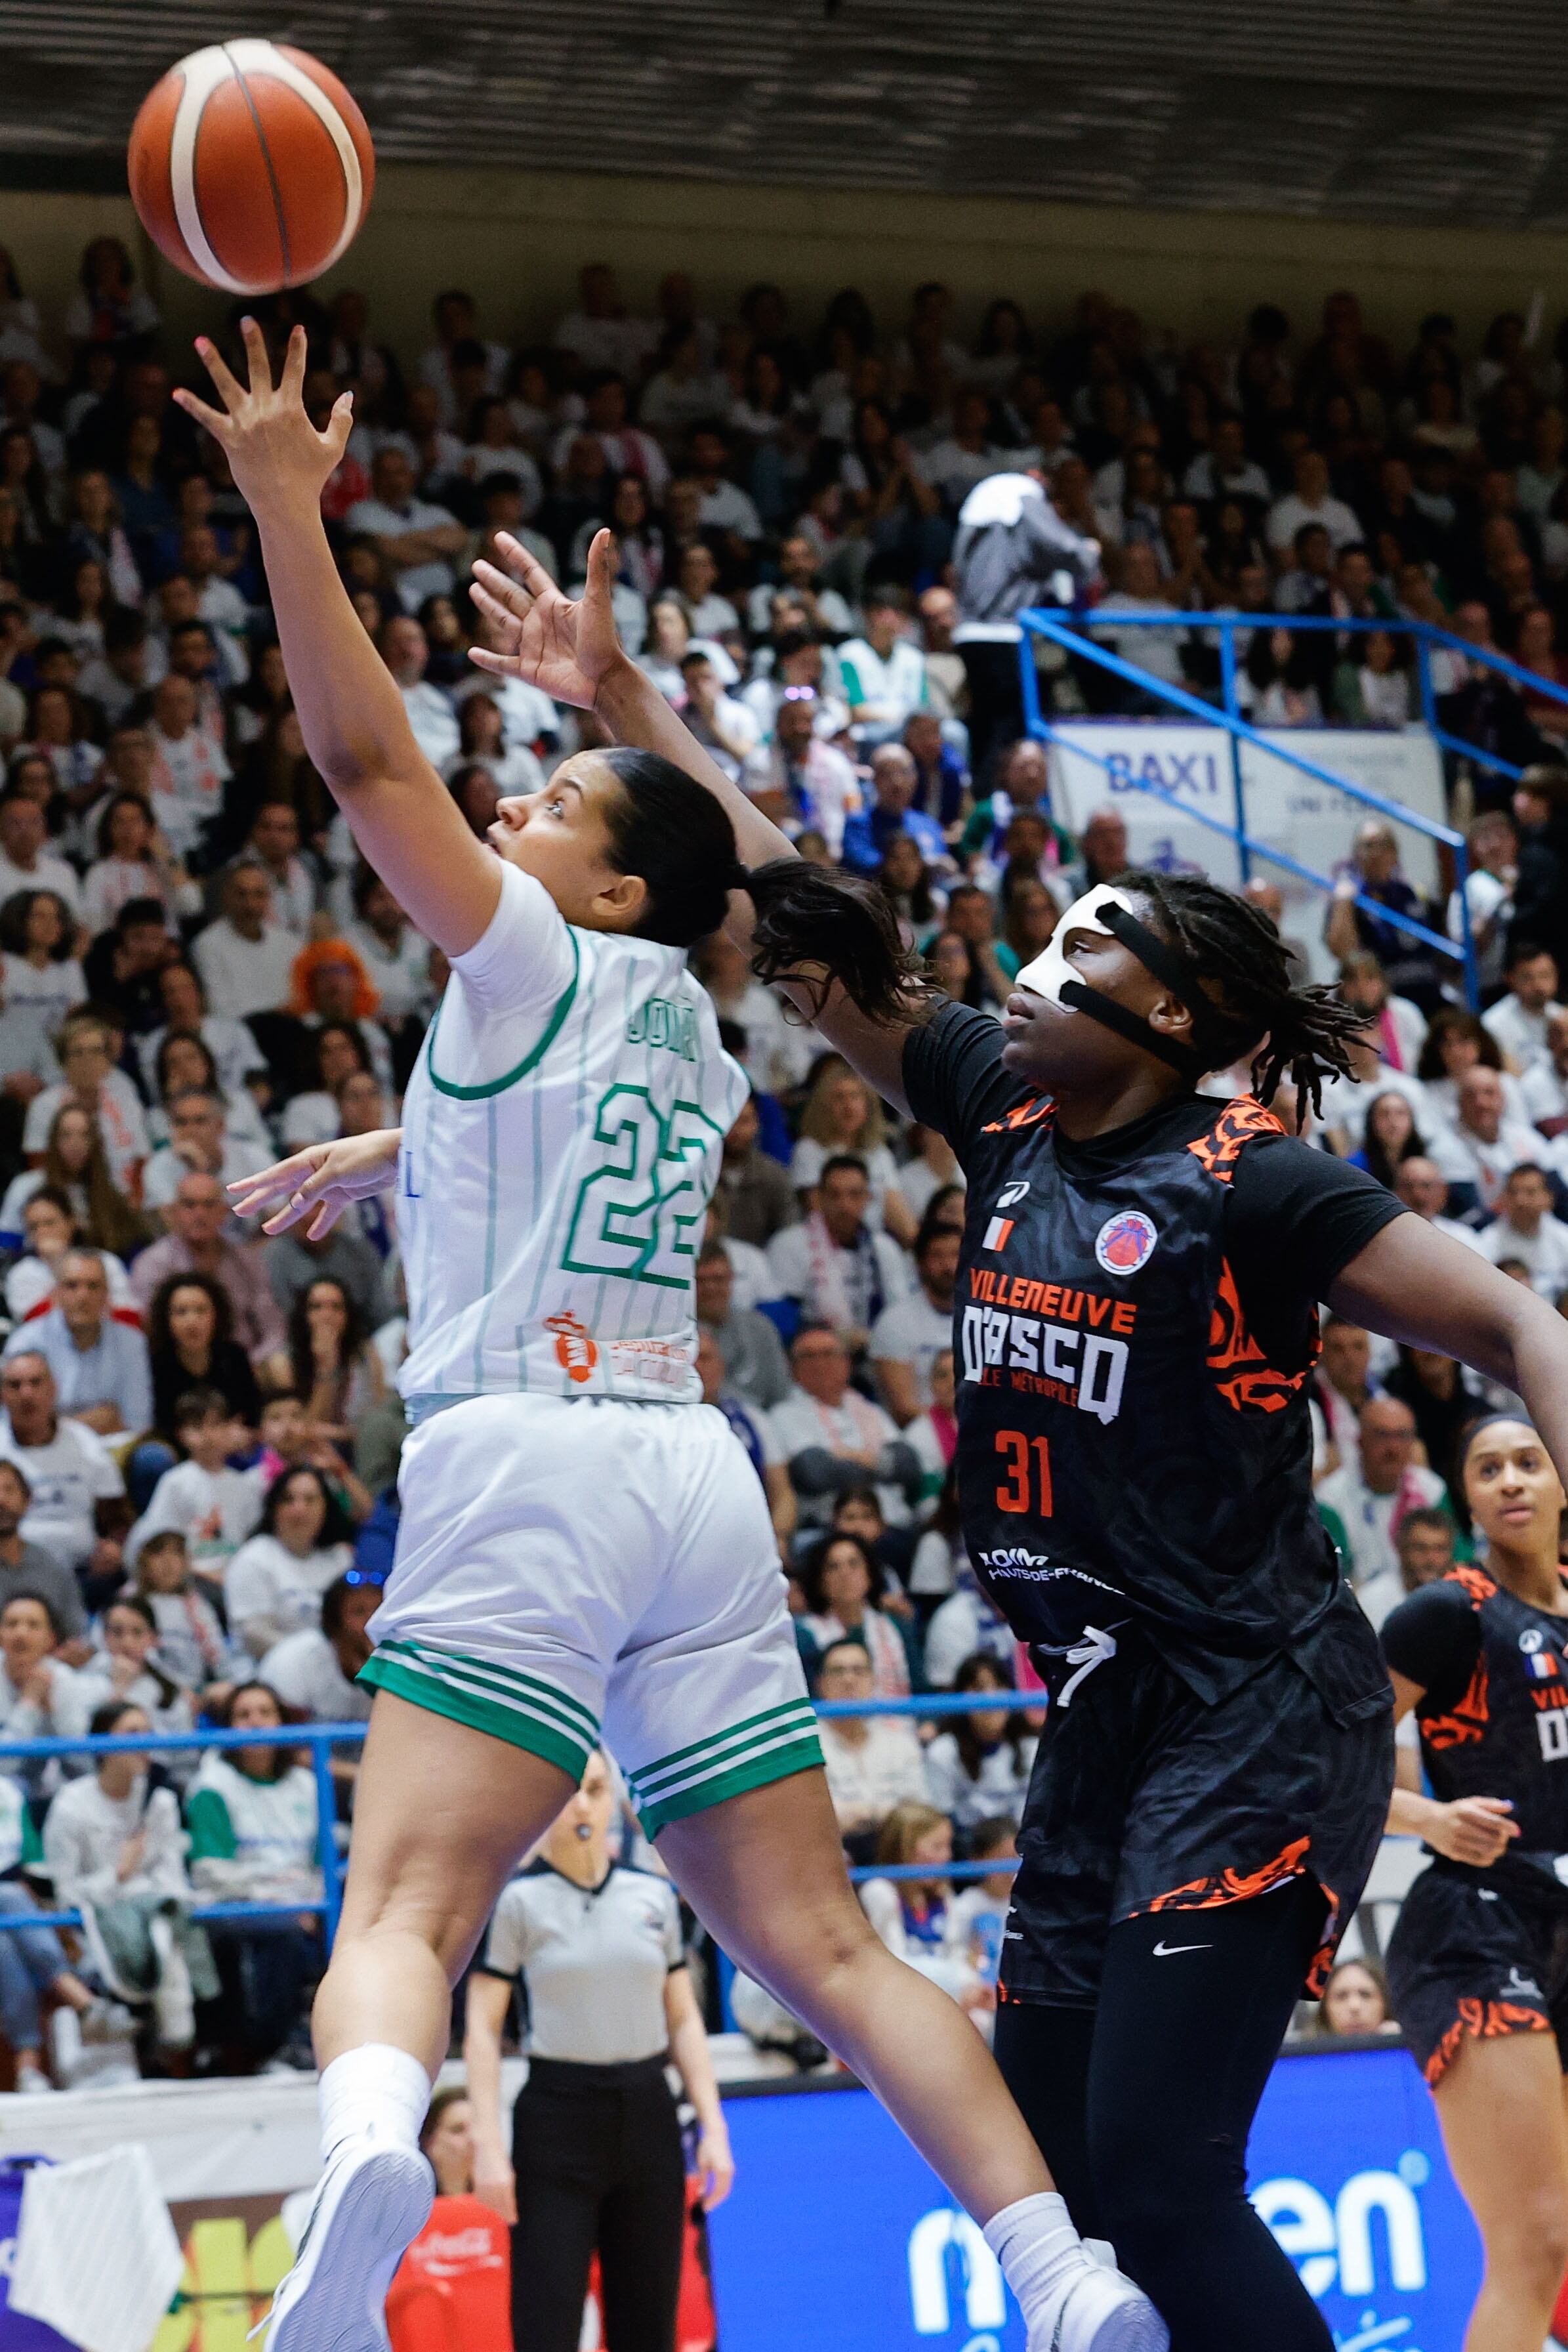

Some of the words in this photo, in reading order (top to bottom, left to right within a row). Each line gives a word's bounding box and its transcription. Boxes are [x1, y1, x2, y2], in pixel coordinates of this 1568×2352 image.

[1107, 753, 1217, 793] BAXI
[559, 1083, 724, 1290] 22
[970, 1268, 1138, 1334] VILLENEUVE
[962, 1305, 1129, 1425] D'ASCQ
[995, 1430, 1052, 1517] 31
